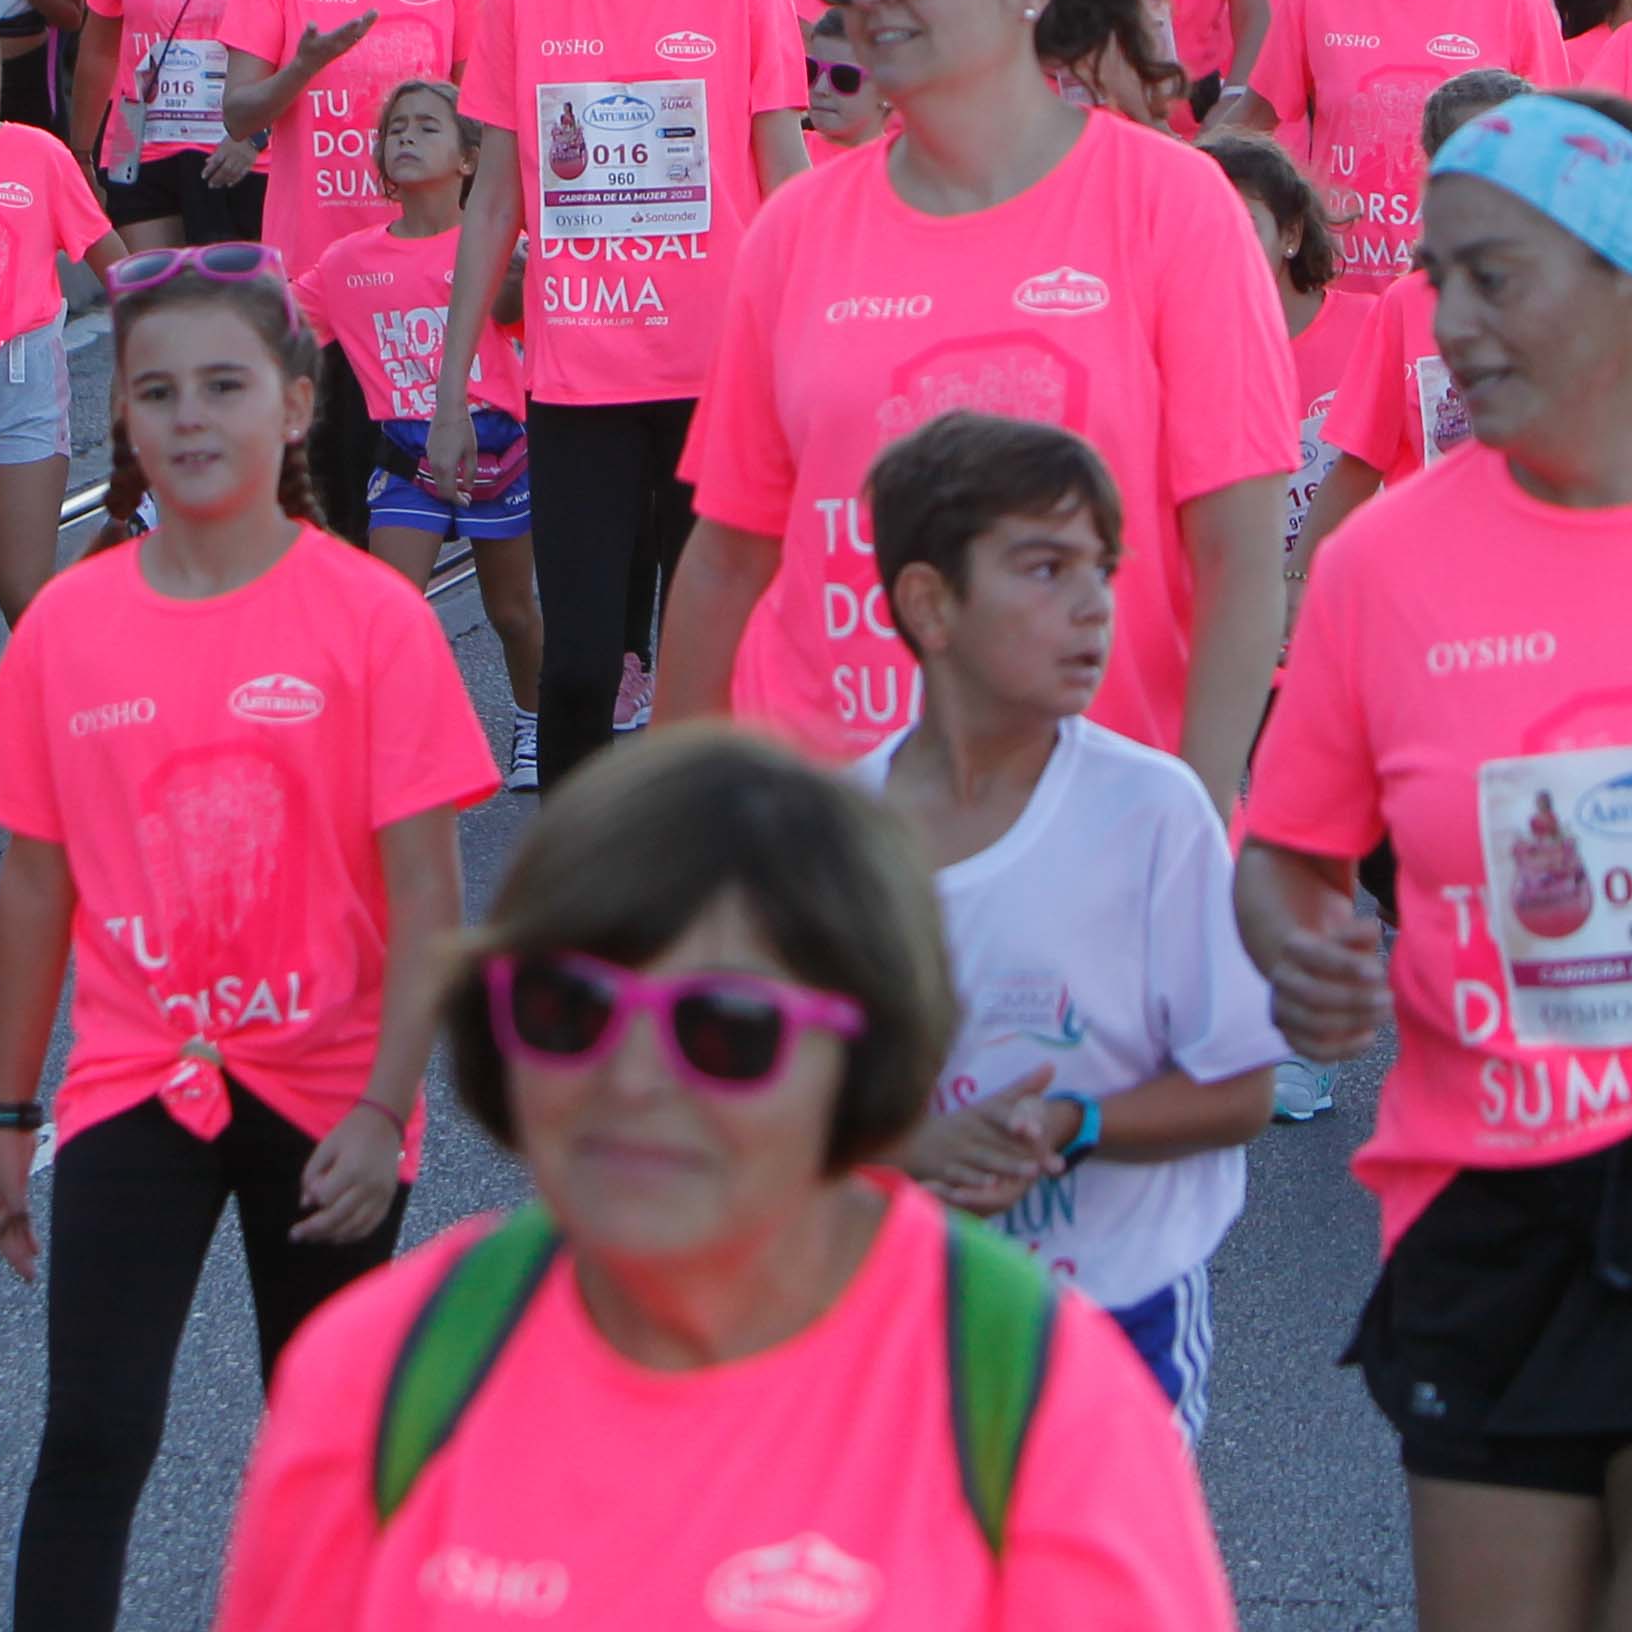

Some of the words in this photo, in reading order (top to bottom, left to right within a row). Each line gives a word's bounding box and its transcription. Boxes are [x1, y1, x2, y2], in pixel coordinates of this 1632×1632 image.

[541, 39, 604, 56] OYSHO
[661, 43, 713, 55] ASTURIANA
[1325, 33, 1380, 49] OYSHO
[1431, 42, 1477, 57] ASTURIANA
[161, 81, 194, 96] 016
[308, 89, 349, 118] TU
[660, 100, 693, 111] SUMA
[589, 110, 650, 122] ASTURIANA
[593, 143, 648, 165] 016
[1331, 145, 1355, 176] TU
[316, 170, 384, 197] SUM
[608, 172, 635, 185] 960
[559, 194, 601, 203] CARRERA
[603, 193, 618, 202] DE
[619, 193, 632, 202] LA
[633, 191, 667, 201] MUJER
[670, 190, 693, 199] 2023
[556, 214, 603, 227] OYSHO
[645, 212, 696, 223] Santander
[542, 235, 708, 261] DORSAL
[1342, 235, 1414, 267] UMA
[347, 272, 394, 288] OYSHO
[544, 276, 664, 313] SUMA
[1023, 287, 1103, 304] ASTURIANA
[825, 295, 933, 324] OYSHO
[645, 316, 668, 326] 2023
[1288, 482, 1318, 508] 16
[815, 498, 875, 556] TU
[825, 584, 899, 639] DO
[1427, 632, 1556, 674] OYSHO
[240, 694, 317, 711] ASTURIANA
[71, 697, 156, 737] OYSHO
[1539, 959, 1626, 983] CARRERA
